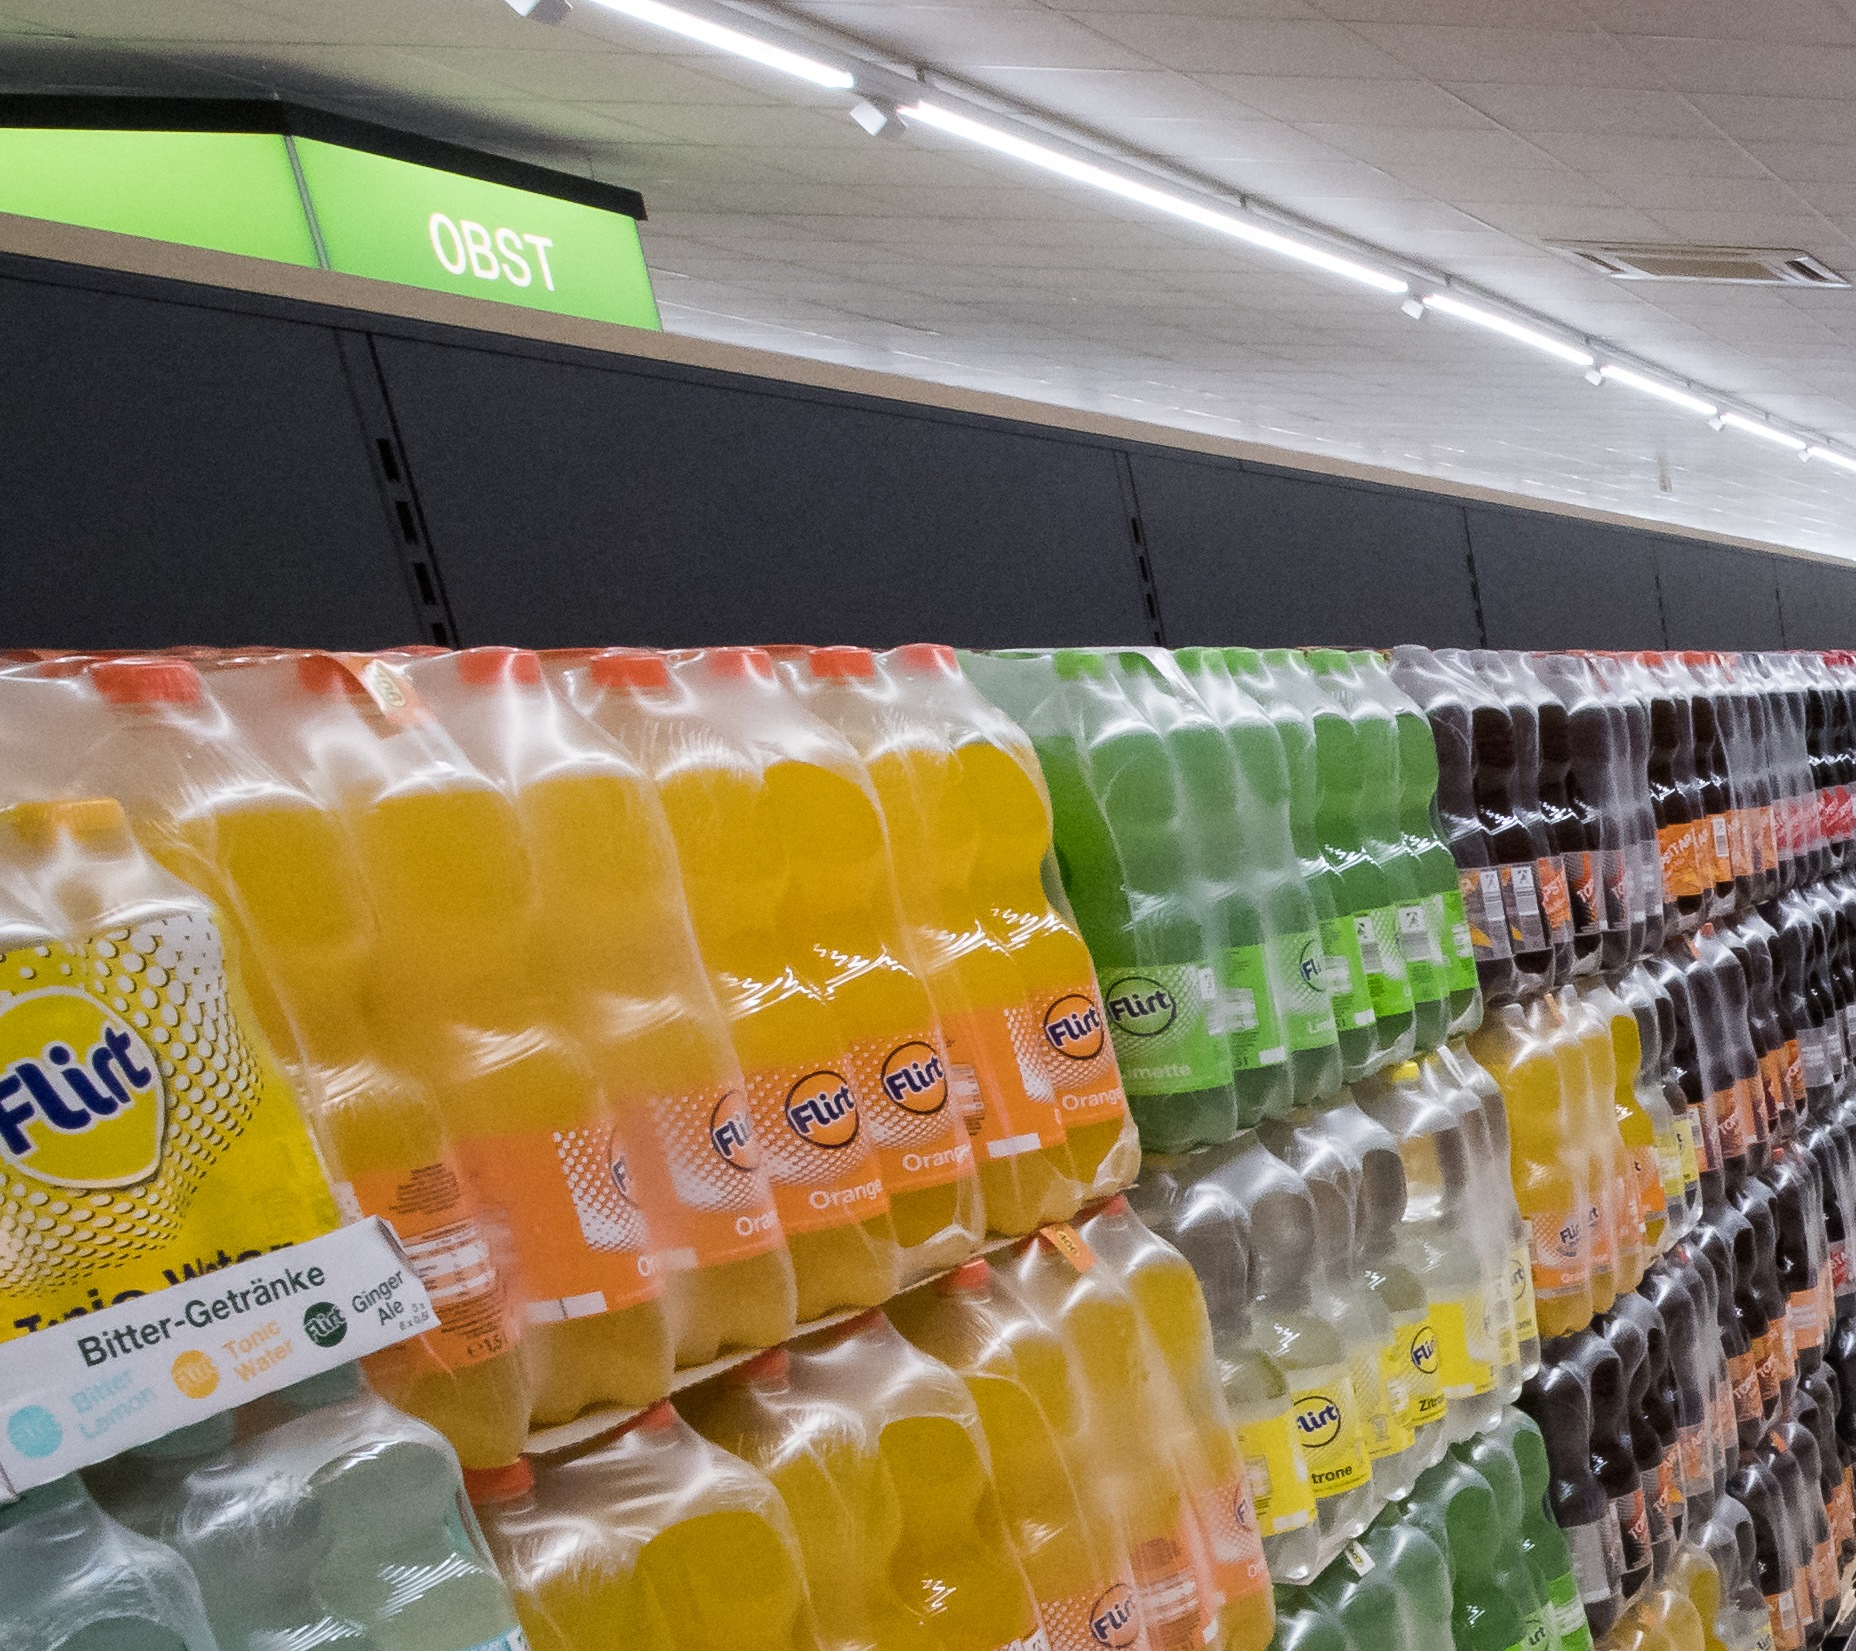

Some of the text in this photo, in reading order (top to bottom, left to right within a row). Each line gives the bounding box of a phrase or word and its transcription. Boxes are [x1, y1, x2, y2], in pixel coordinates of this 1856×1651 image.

[428, 212, 556, 292] OBST
[1049, 1005, 1101, 1046] Flirt
[1108, 991, 1168, 1023] Flirt
[0, 1027, 151, 1156] Flirt
[886, 1056, 944, 1104] Flirt
[1122, 1062, 1191, 1082] imette
[788, 1085, 854, 1135] Flirt
[809, 1176, 884, 1211] Orange
[350, 1270, 405, 1314] Ginger
[376, 1296, 405, 1326] Ale
[77, 1261, 326, 1369] Bitter-Getränke
[222, 1317, 282, 1360] Tonic
[1311, 1465, 1353, 1486] trone
